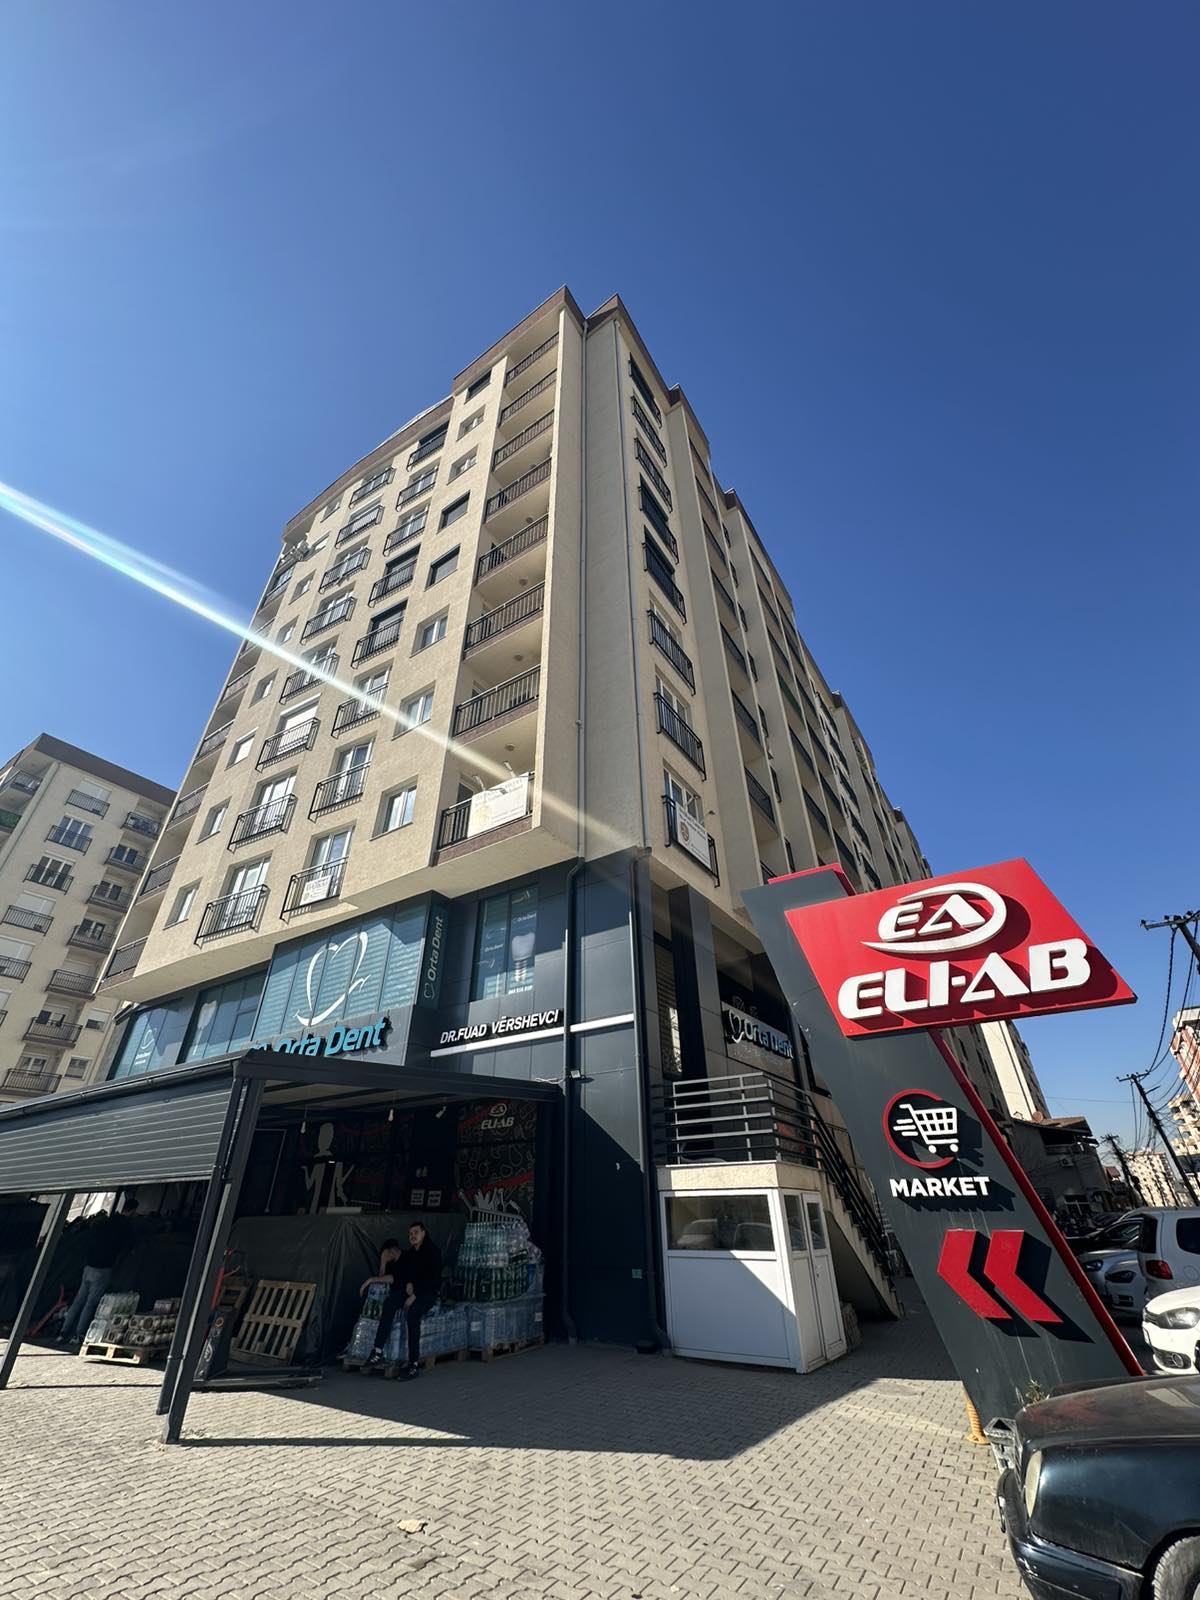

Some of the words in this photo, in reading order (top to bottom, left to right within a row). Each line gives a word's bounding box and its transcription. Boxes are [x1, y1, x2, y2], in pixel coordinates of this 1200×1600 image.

[432, 916, 443, 949] Dent
[878, 894, 986, 942] EA
[428, 949, 439, 981] Orta
[838, 938, 1091, 1020] ELI-AB
[325, 1016, 385, 1056] Dent
[440, 1023, 487, 1044] DR.FUAD
[744, 1019, 769, 1048] Orta
[770, 1031, 794, 1059] Dent
[889, 1176, 990, 1197] MARKET
